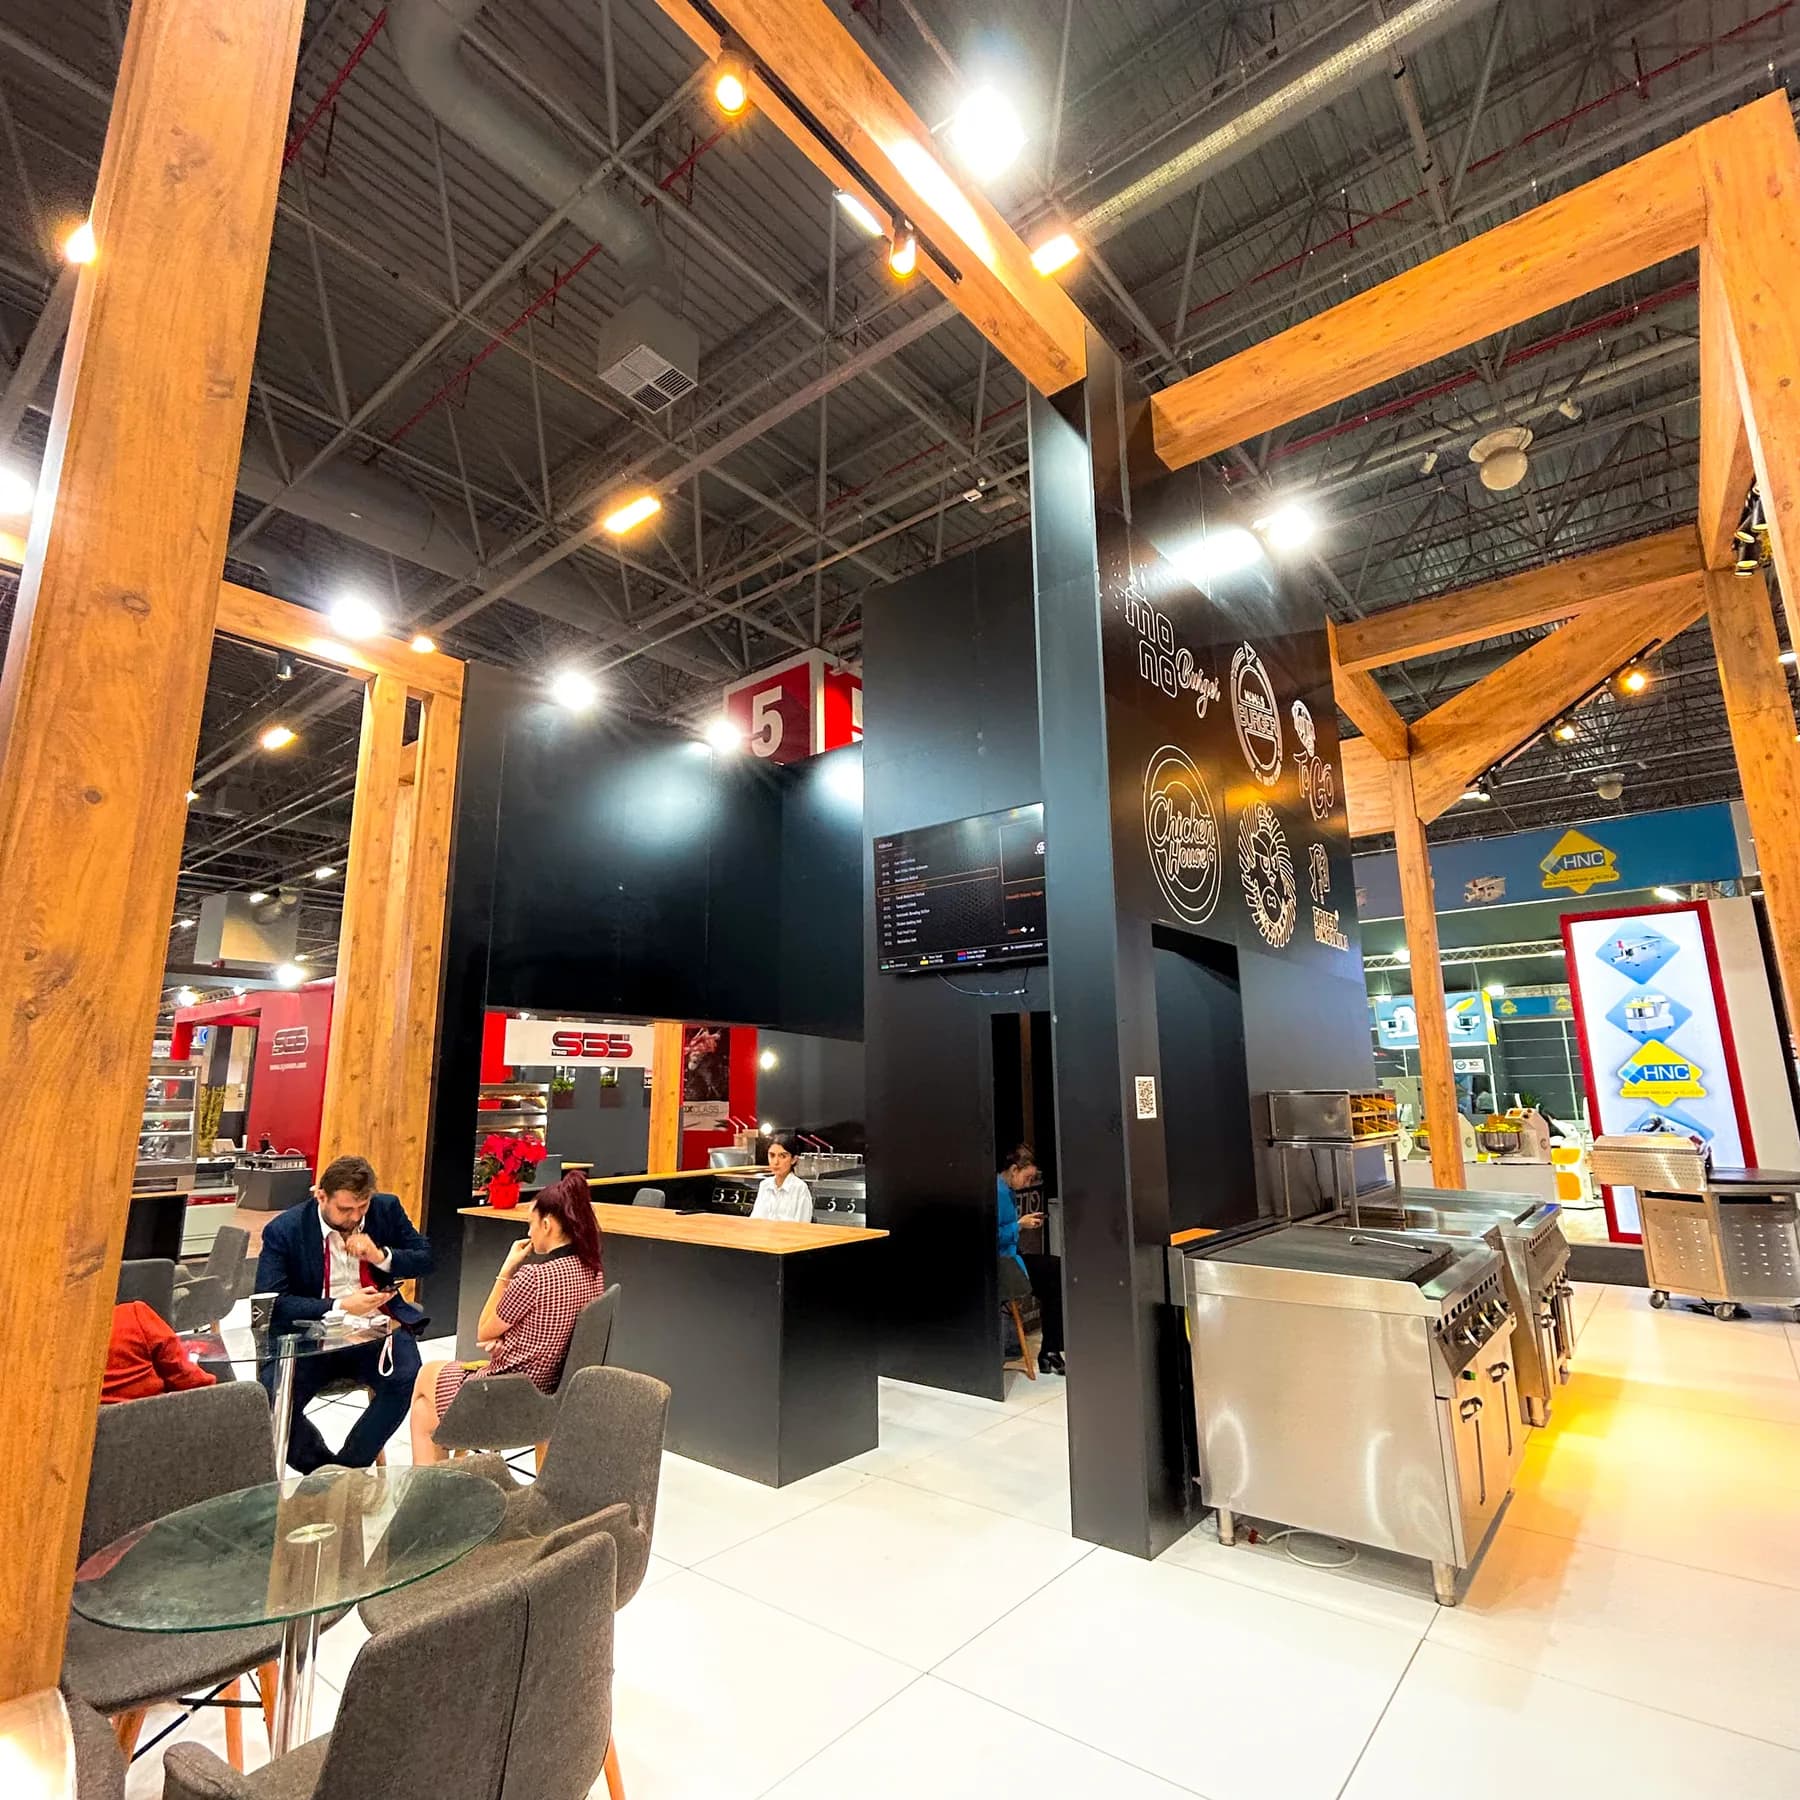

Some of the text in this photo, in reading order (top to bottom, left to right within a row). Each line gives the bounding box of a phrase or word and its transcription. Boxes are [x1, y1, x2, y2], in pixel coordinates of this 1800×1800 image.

[751, 685, 784, 758] 5
[1238, 704, 1278, 738] BURGER
[1149, 796, 1216, 847] Chicken
[1168, 840, 1208, 875] House
[1563, 851, 1605, 869] HNC
[1643, 1065, 1690, 1080] HNC
